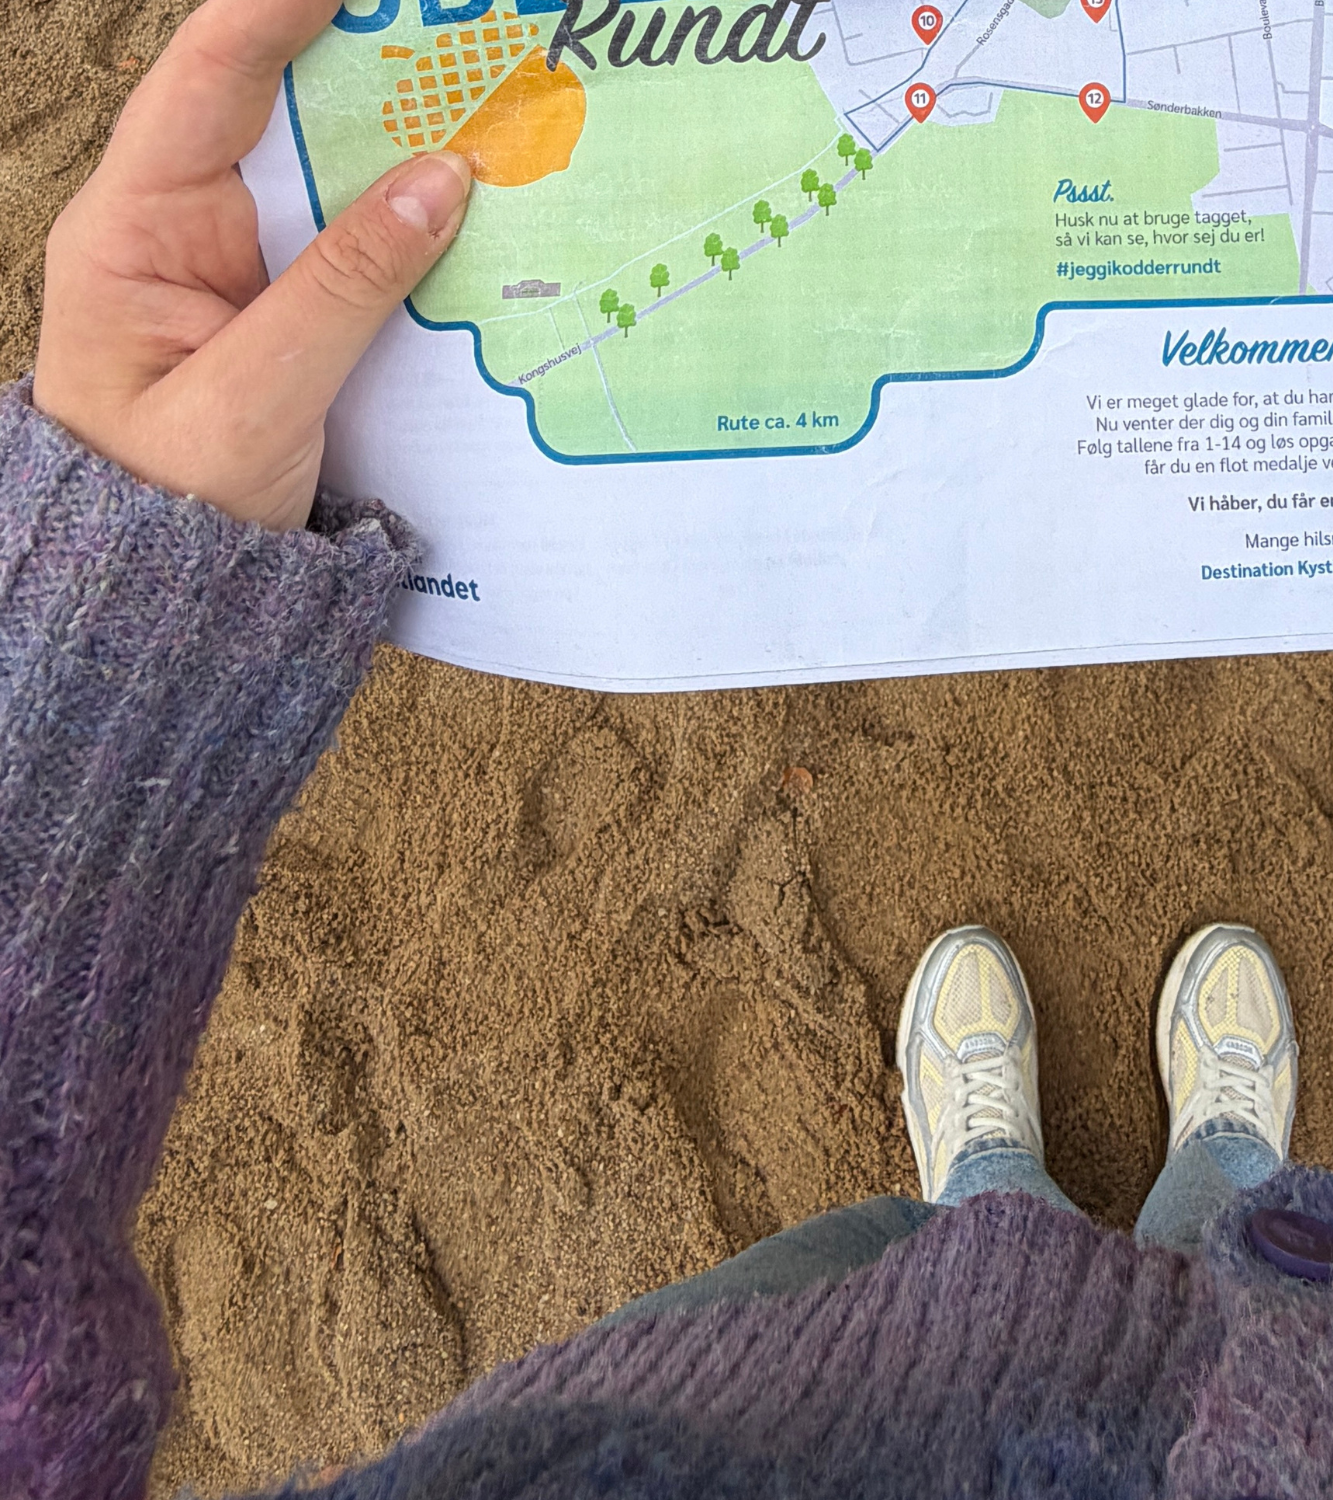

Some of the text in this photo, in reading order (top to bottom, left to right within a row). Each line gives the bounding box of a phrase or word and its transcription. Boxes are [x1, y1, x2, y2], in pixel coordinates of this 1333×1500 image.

[919, 14, 935, 27] 10
[913, 92, 926, 105] 11
[1087, 92, 1102, 105] 12
[1147, 100, 1222, 119] Sønderbakken
[1054, 179, 1114, 203] Pssst.
[1056, 210, 1251, 228] Husk nu at bruge tagget,
[1056, 228, 1264, 247] så vi kan se, hvor sej du er!
[1057, 258, 1221, 280] #jeggikodderrundt
[518, 343, 581, 385] Kongshusvej
[1087, 395, 1101, 409] Vi
[1107, 399, 1122, 409] er
[1128, 395, 1178, 412] meget
[1184, 392, 1228, 411] glade
[1233, 392, 1258, 408] for,
[1263, 392, 1279, 405] at
[1284, 390, 1303, 404] du
[718, 411, 838, 431] Rute ca. 4 km
[1097, 417, 1117, 432] Nu
[1123, 417, 1174, 430] venter
[1179, 415, 1205, 429] der
[1210, 414, 1234, 432] dig
[1239, 417, 1258, 431] og
[1264, 412, 1287, 427] din
[1078, 439, 1111, 458] Følg
[1117, 438, 1172, 453] tallene
[1178, 437, 1199, 451] fra
[1206, 436, 1241, 450] 1-14
[1246, 439, 1265, 453] og
[1271, 434, 1294, 449] løs
[1145, 460, 1165, 474] får
[1171, 459, 1190, 473] du
[1196, 462, 1214, 473] en
[1220, 457, 1248, 472] flot
[1254, 455, 1317, 473] medalje
[1188, 497, 1204, 511] Vi
[1210, 495, 1262, 512] håber,
[1267, 494, 1287, 509] du
[1292, 493, 1315, 508] får
[1246, 534, 1299, 551] Mange
[1202, 562, 1293, 579] Destination
